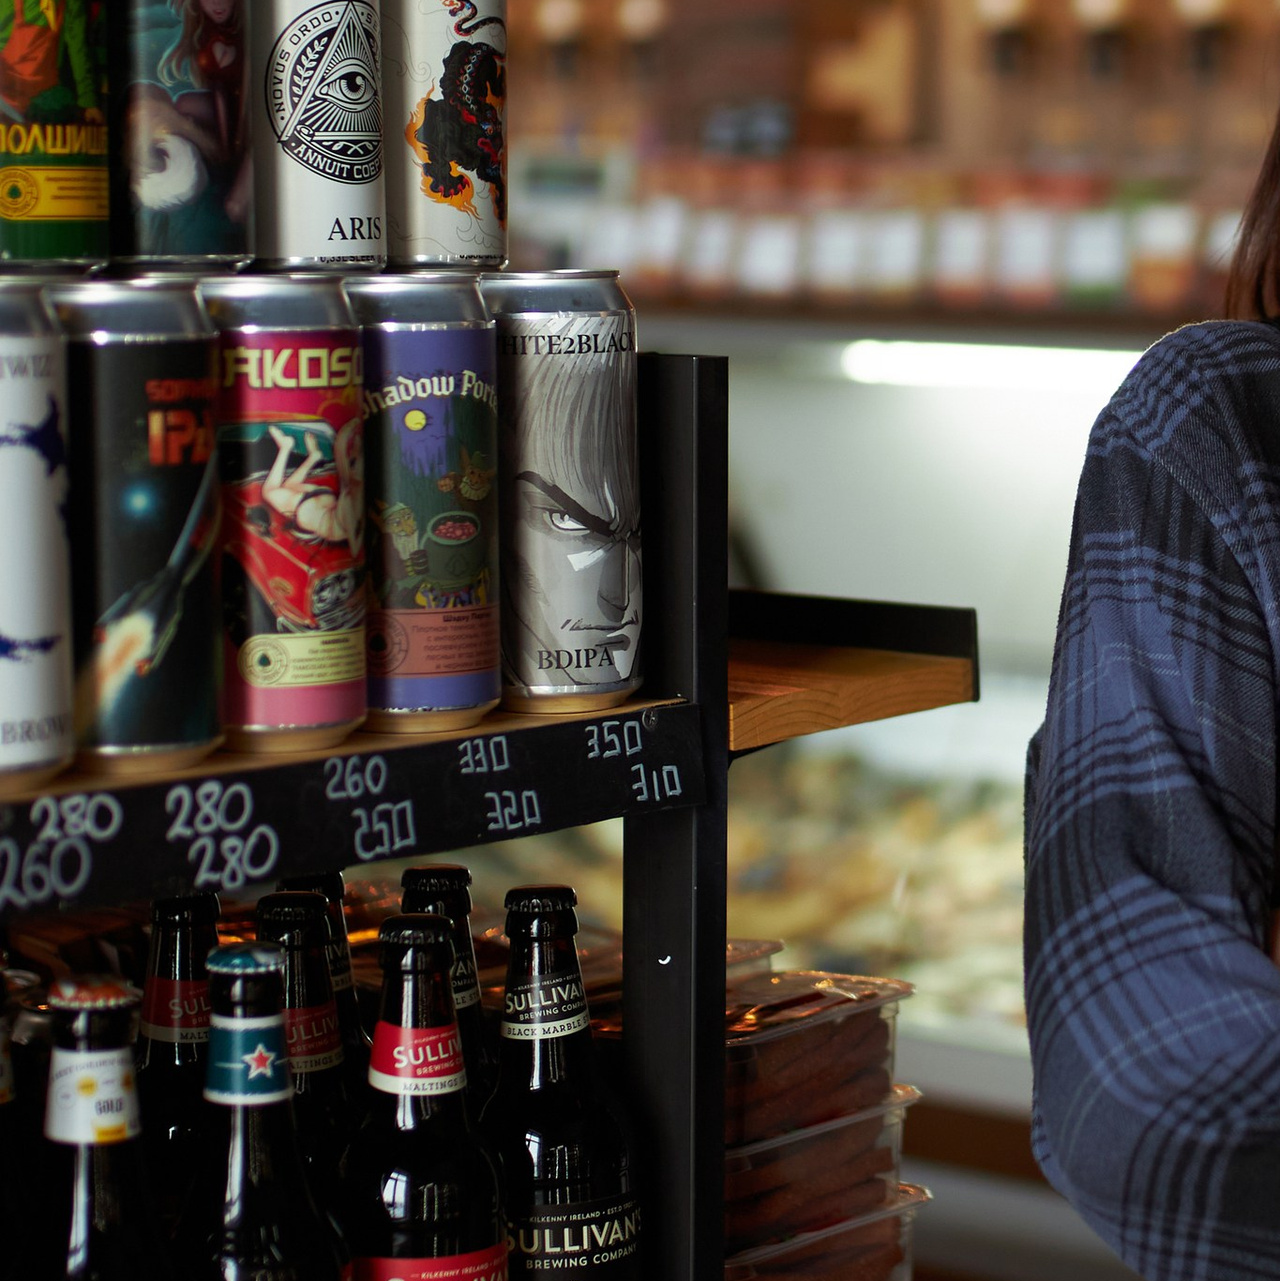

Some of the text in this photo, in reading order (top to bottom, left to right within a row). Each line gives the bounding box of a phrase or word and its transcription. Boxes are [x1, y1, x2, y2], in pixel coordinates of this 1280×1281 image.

[273, 10, 333, 112] NOVUS ORDO
[293, 143, 351, 177] ANNUIT
[328, 217, 381, 241] ARIS
[501, 331, 636, 357] HITE2BLACK
[537, 647, 615, 670] BDIPA
[29, 720, 643, 843] 280 280 260 330 350
[0, 762, 683, 909] 260 280 250 320 310
[519, 1006, 559, 1021] BREWING
[507, 1027, 537, 1036] BLACK
[542, 1019, 581, 1035] MARBLE
[529, 1214, 568, 1223] KILKENNY
[569, 1210, 600, 1220] IRELAND
[526, 1255, 588, 1270] BREWING
[592, 1242, 638, 1265] COMPANY
[421, 1268, 461, 1280] KILKENNY
